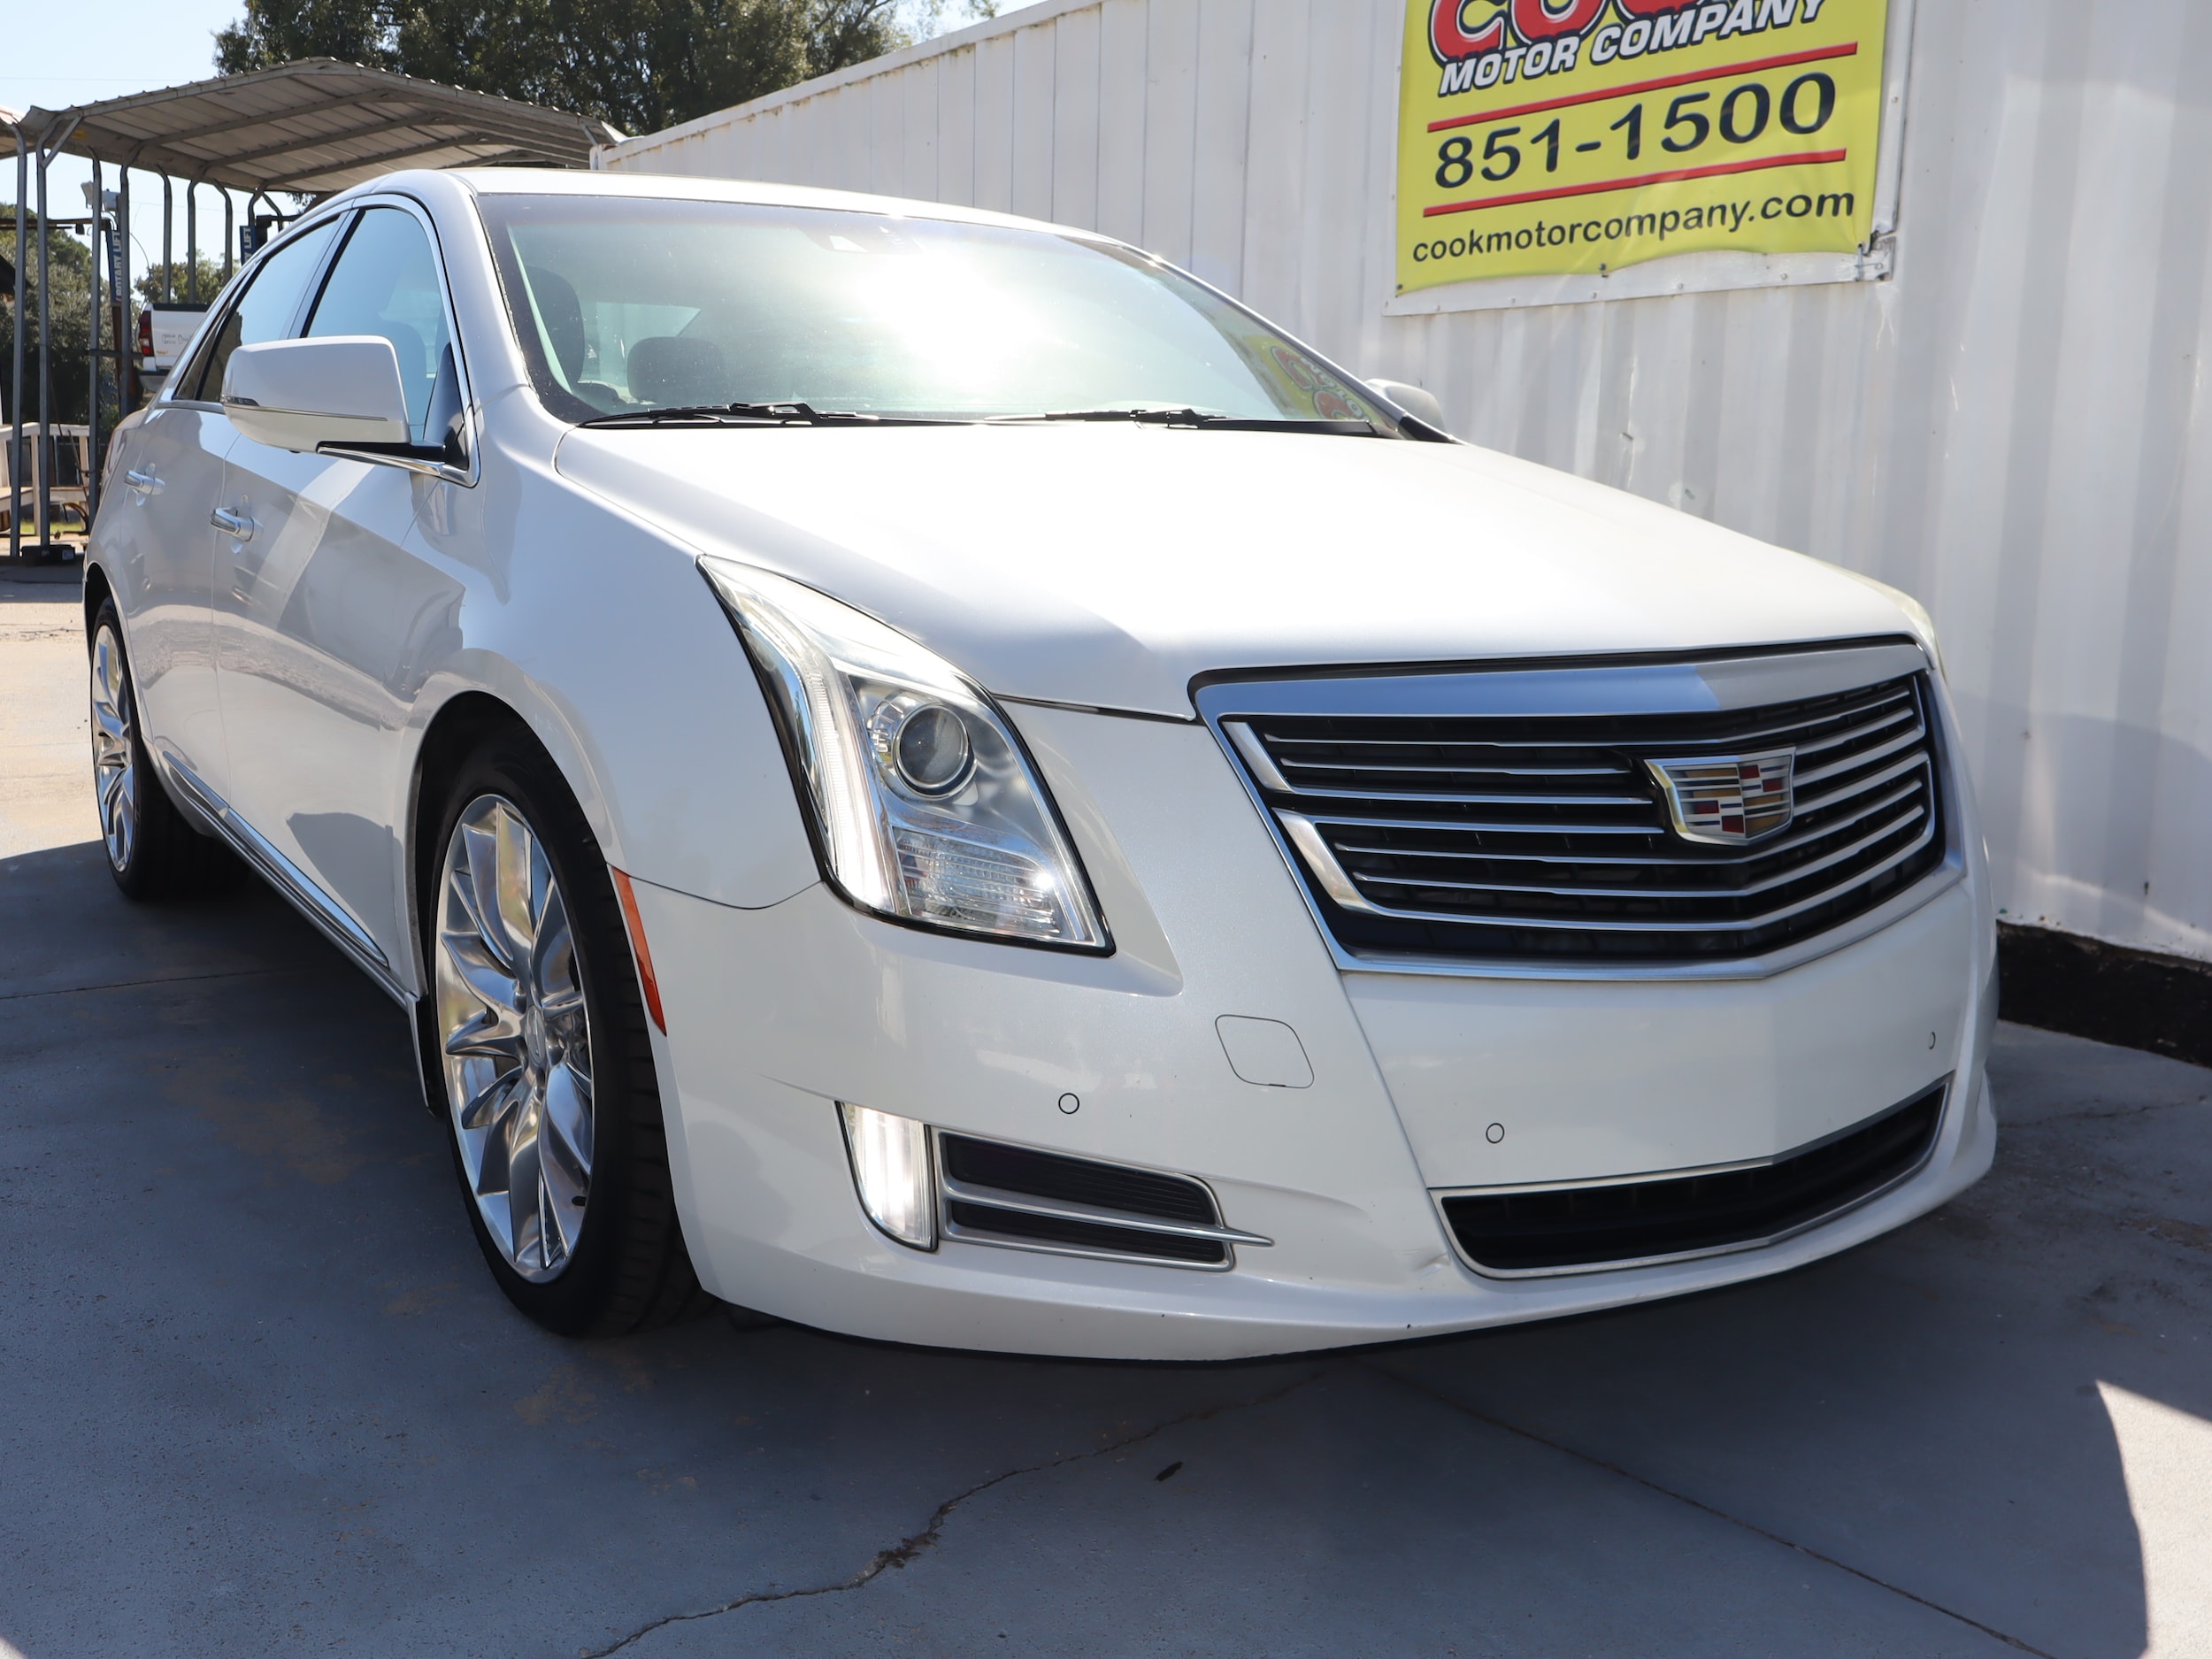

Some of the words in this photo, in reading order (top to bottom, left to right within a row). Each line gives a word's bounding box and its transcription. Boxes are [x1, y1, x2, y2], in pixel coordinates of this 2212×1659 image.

[1438, 35, 1581, 97] MOTOR
[1590, 0, 1824, 65] COMPANY
[1434, 71, 1837, 189] 851-1500
[1412, 192, 1855, 263] cookmotorcompany.com
